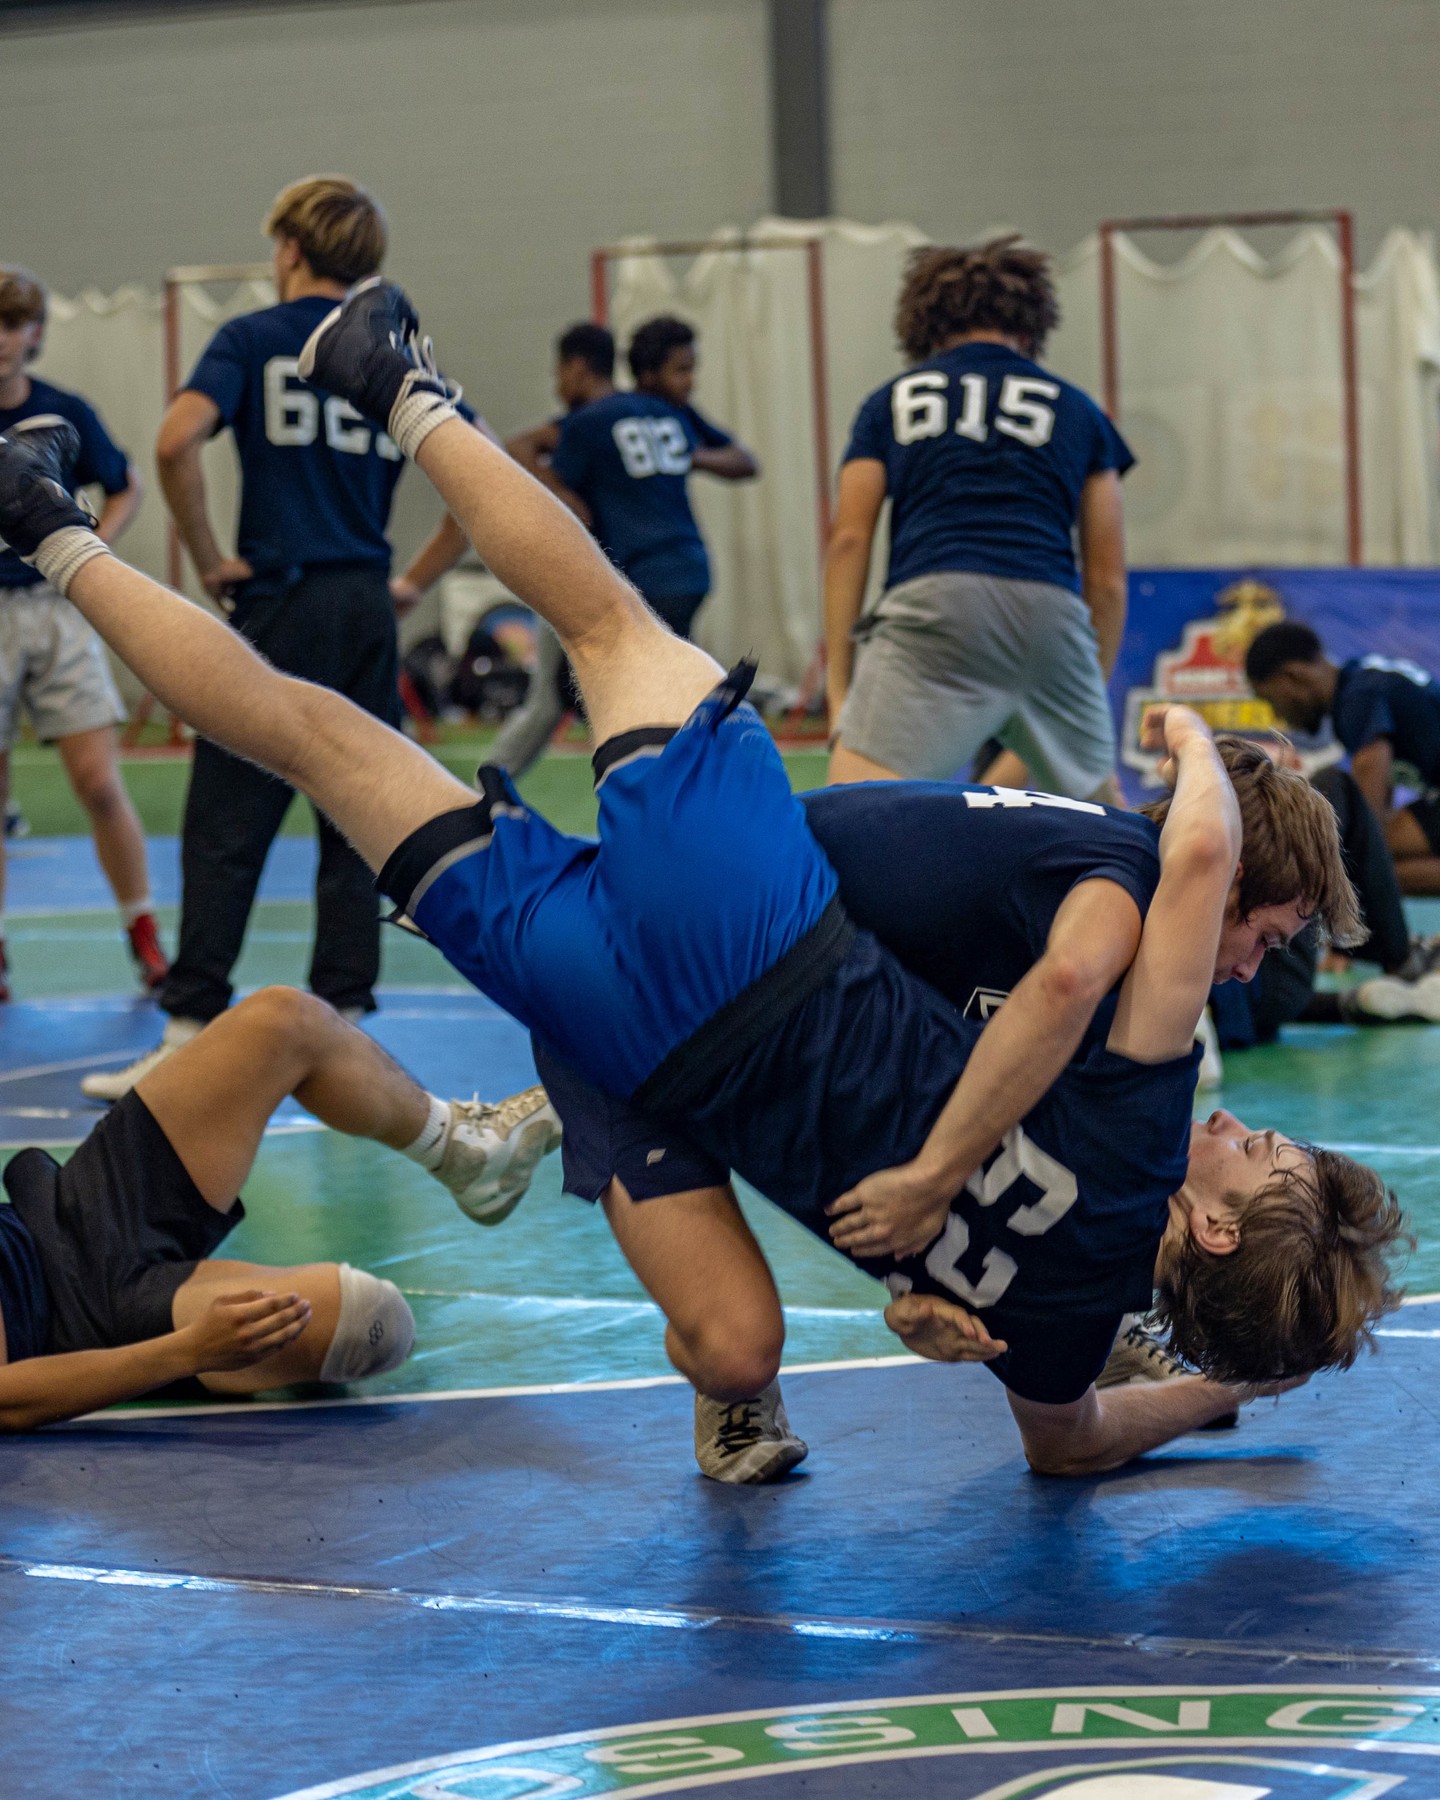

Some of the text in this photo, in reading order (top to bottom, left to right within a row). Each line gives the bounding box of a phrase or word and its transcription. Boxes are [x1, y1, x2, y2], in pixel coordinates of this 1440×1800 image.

[263, 355, 400, 462] 62
[891, 371, 1061, 448] 615
[885, 1122, 1079, 1309] 62
